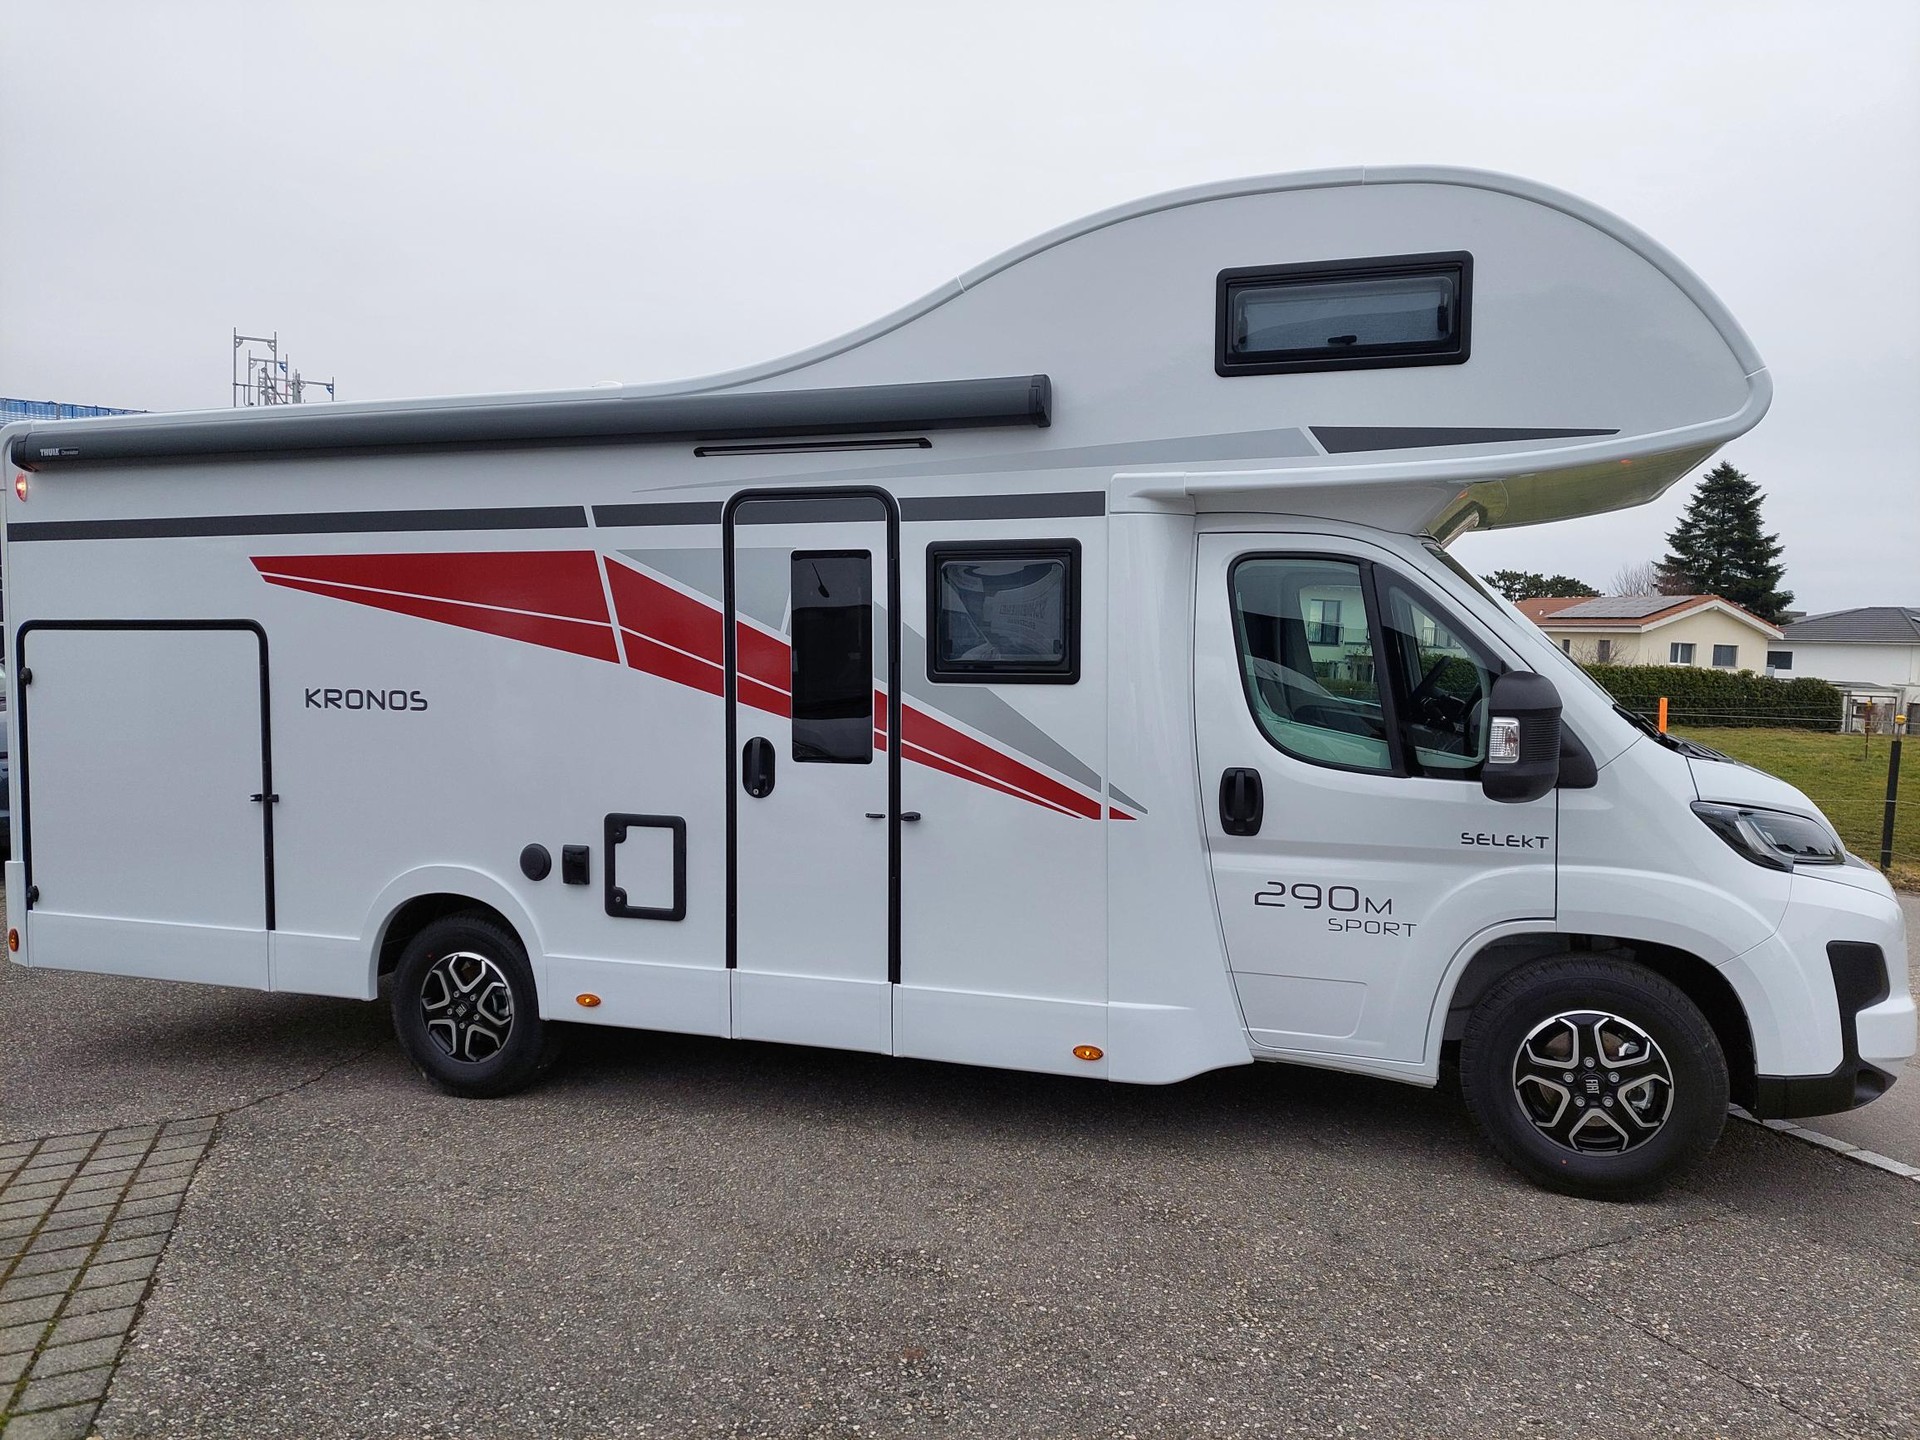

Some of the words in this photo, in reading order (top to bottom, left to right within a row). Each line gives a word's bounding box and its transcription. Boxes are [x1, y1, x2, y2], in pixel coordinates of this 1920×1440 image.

[40, 448, 60, 457] THULE
[305, 688, 428, 711] KRONOS
[1460, 832, 1550, 849] SELEKT
[1254, 881, 1393, 915] 290M
[1327, 917, 1418, 938] SPORT
[1585, 1079, 1600, 1095] FIAT
